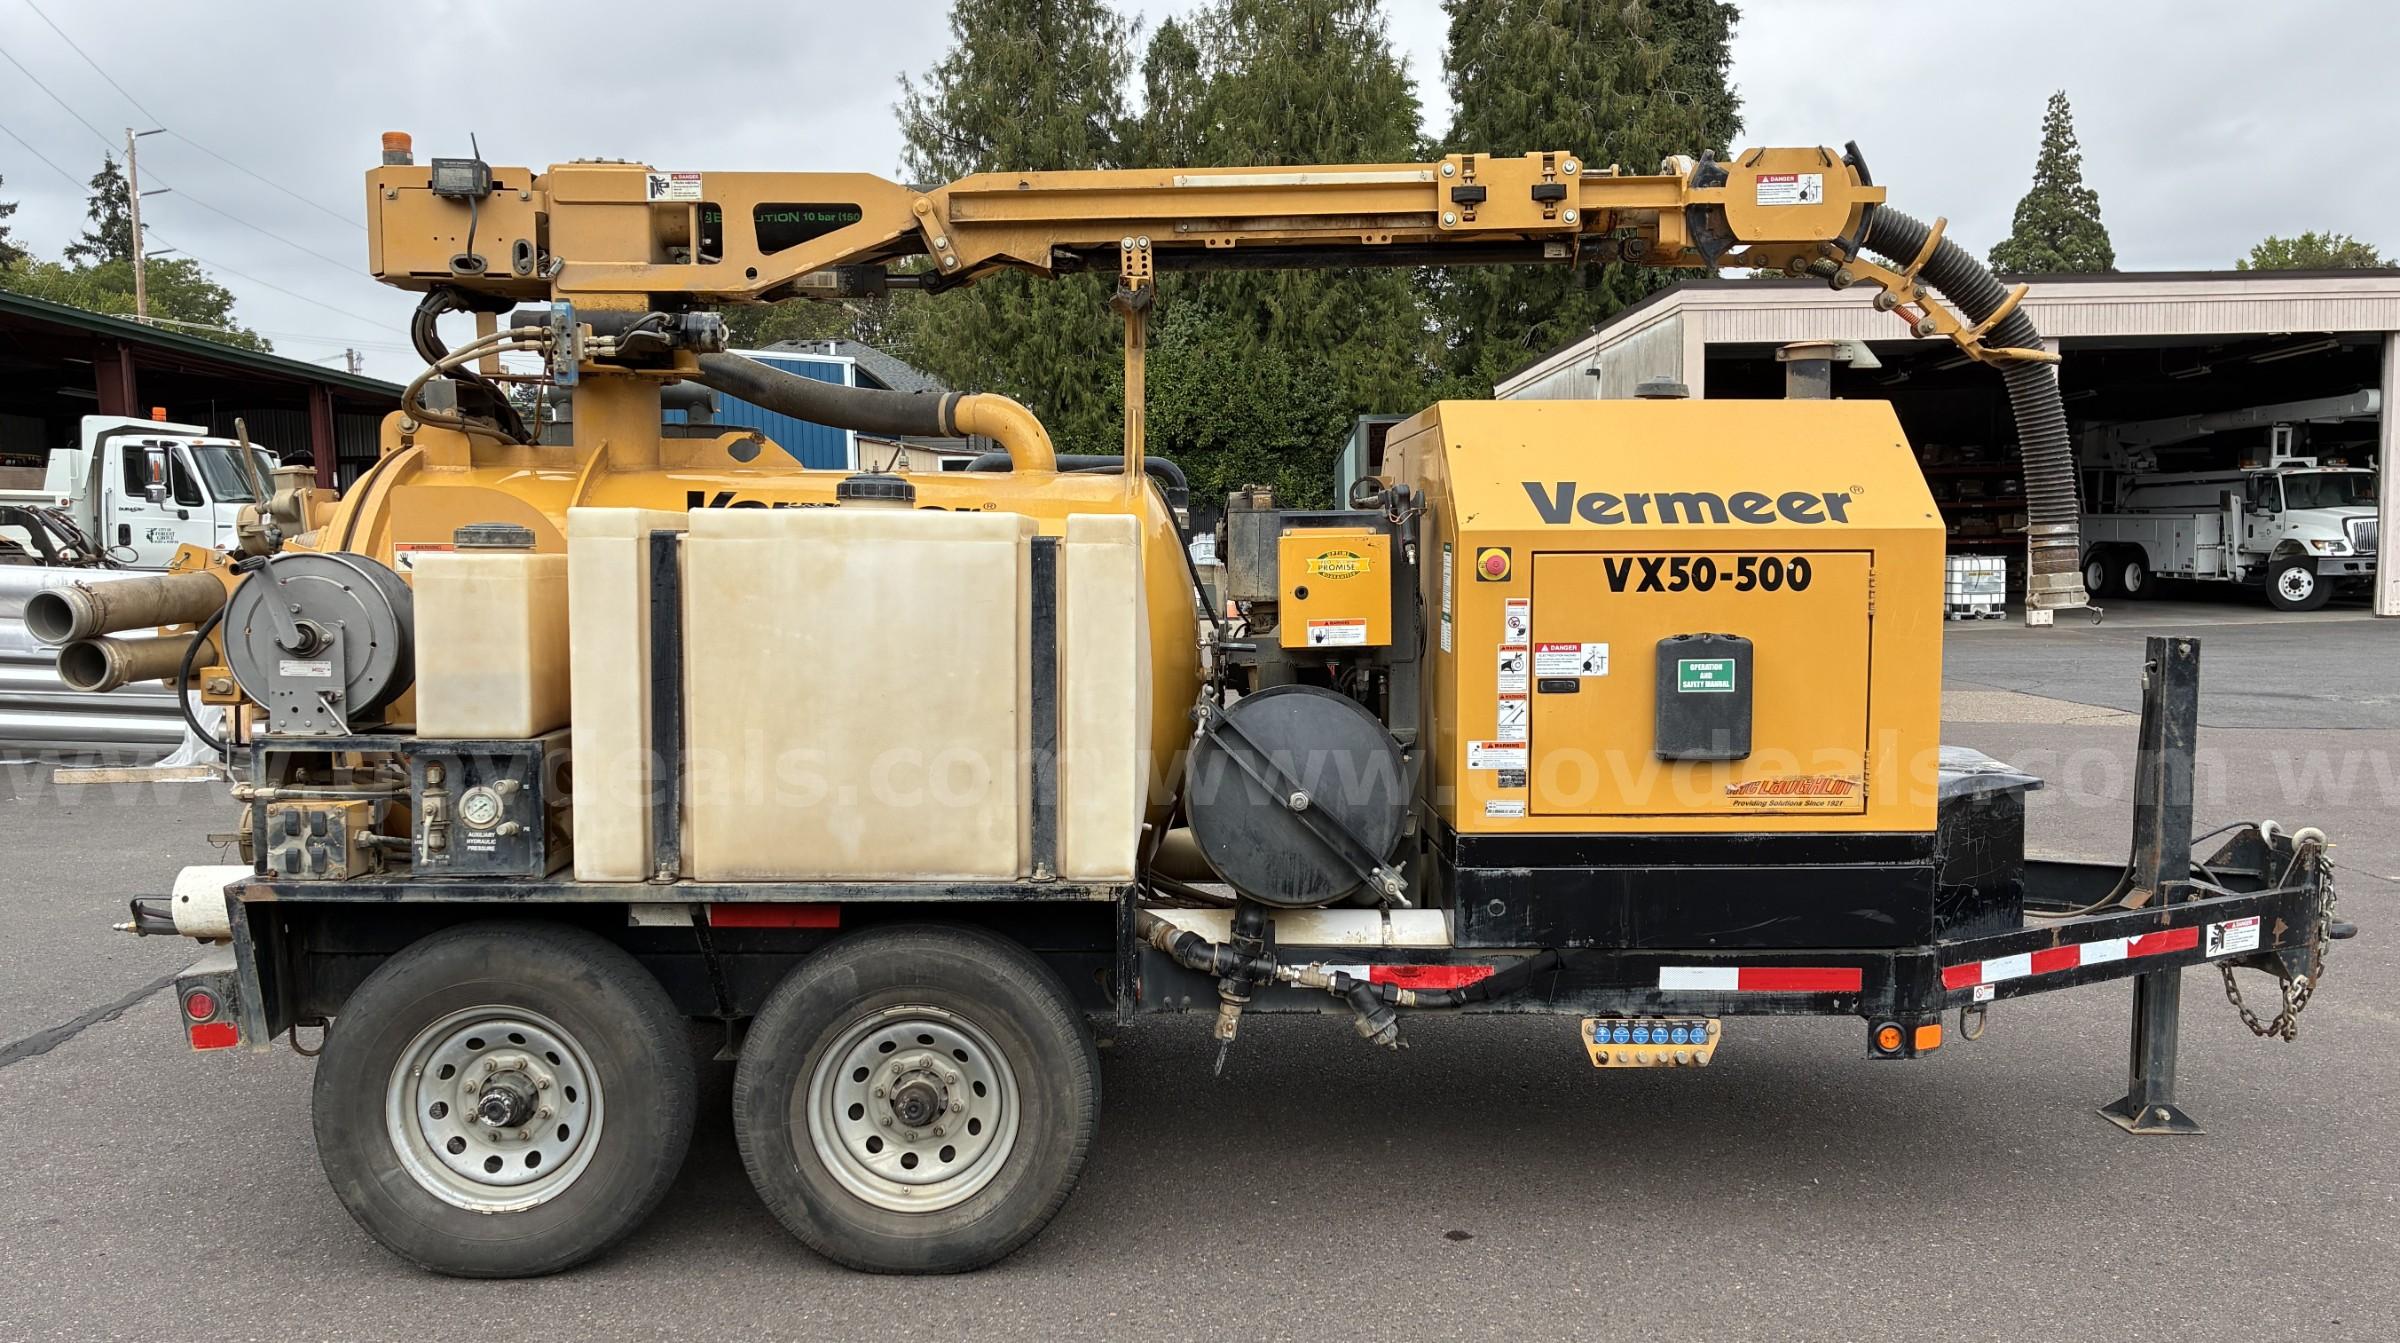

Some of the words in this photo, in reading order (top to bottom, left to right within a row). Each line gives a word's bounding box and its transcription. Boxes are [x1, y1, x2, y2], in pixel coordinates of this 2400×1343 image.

[803, 212, 815, 222] 10
[818, 212, 835, 222] bar
[1603, 556, 1812, 593] VX50-500
[1690, 663, 1723, 671] OPERATION
[1700, 672, 1713, 680] AND
[1732, 800, 1767, 808] Providing
